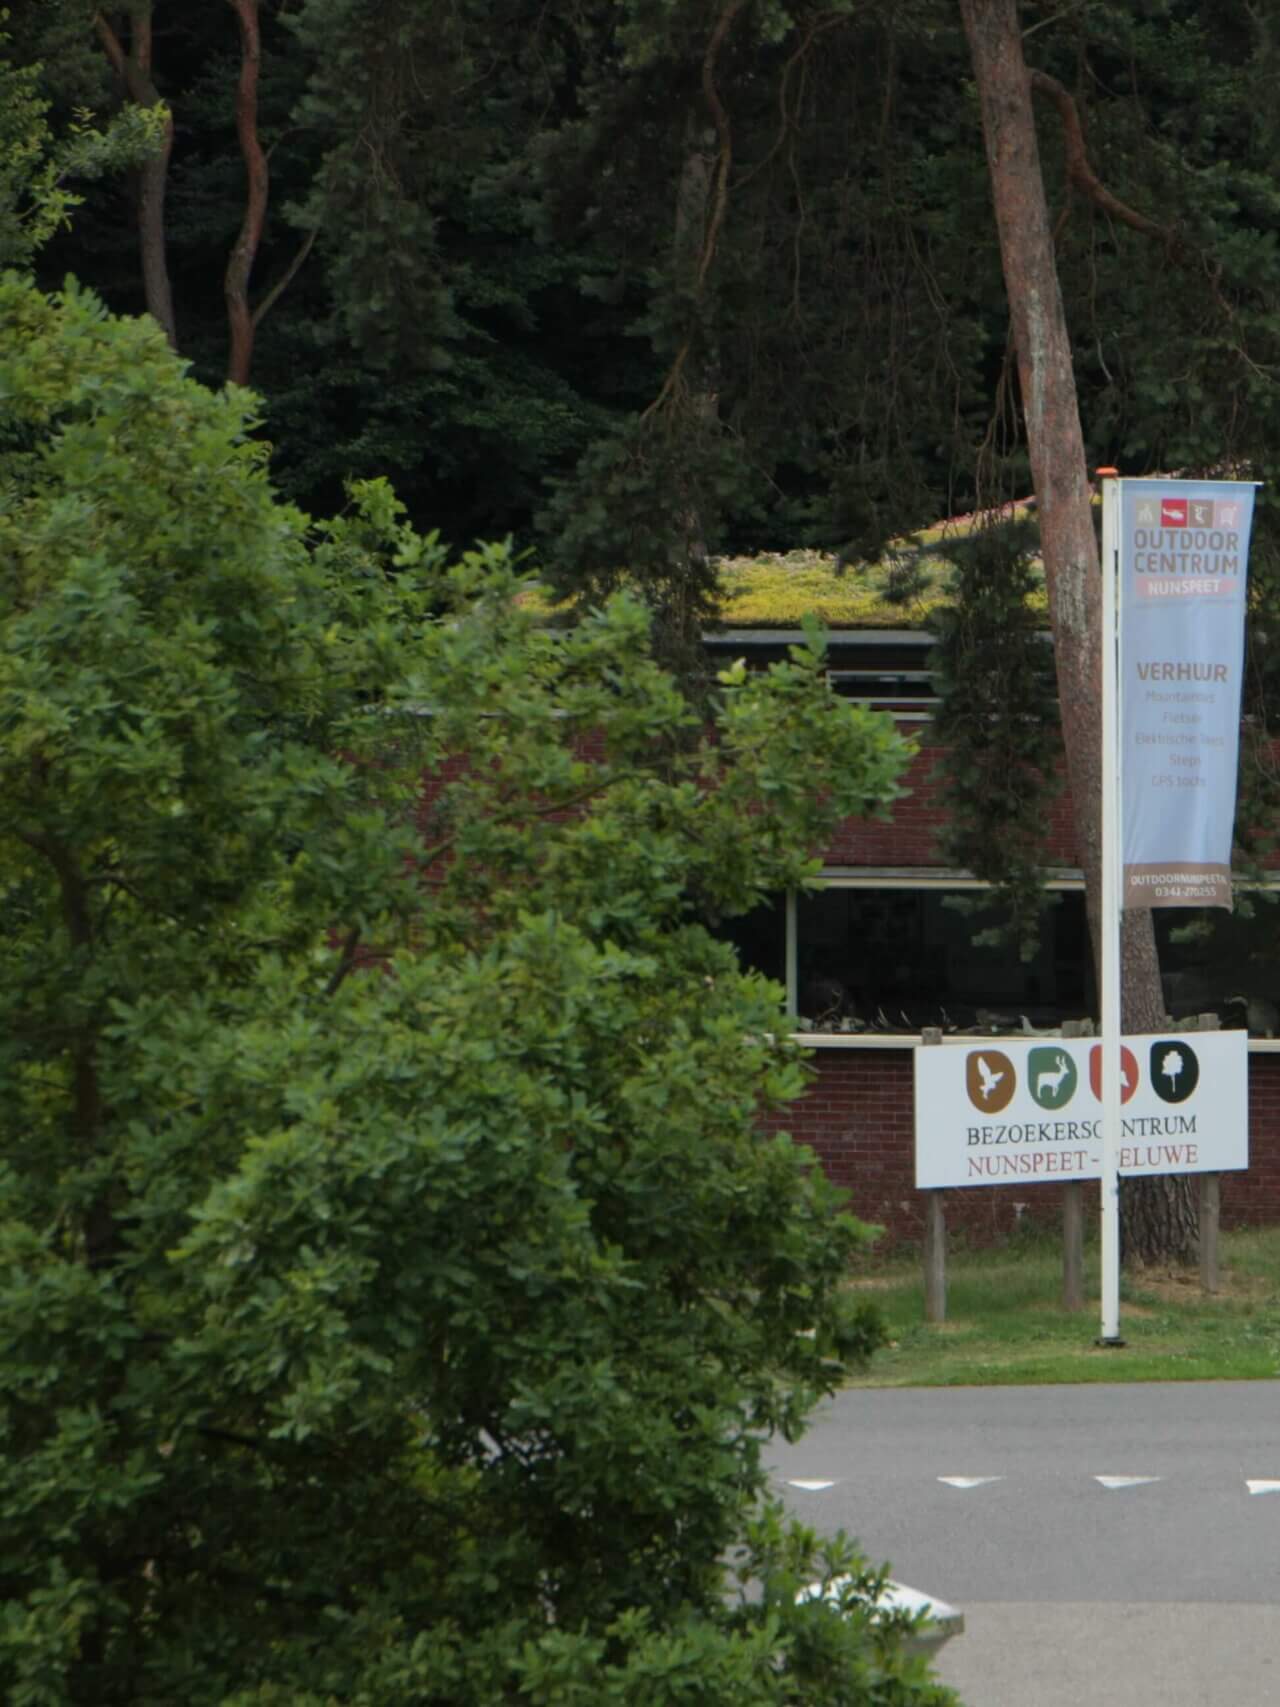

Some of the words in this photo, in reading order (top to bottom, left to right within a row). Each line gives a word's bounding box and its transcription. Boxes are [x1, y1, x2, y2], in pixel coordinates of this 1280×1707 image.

[1134, 529, 1239, 552] OUTDOOR
[1134, 552, 1238, 575] CENTRUM
[1147, 579, 1221, 596] NUNSPEET
[966, 1115, 1198, 1147] BEZOEKERSCNTRUM
[967, 1150, 1088, 1177] NUNSPEET
[1115, 1145, 1199, 1169] ELUWE
